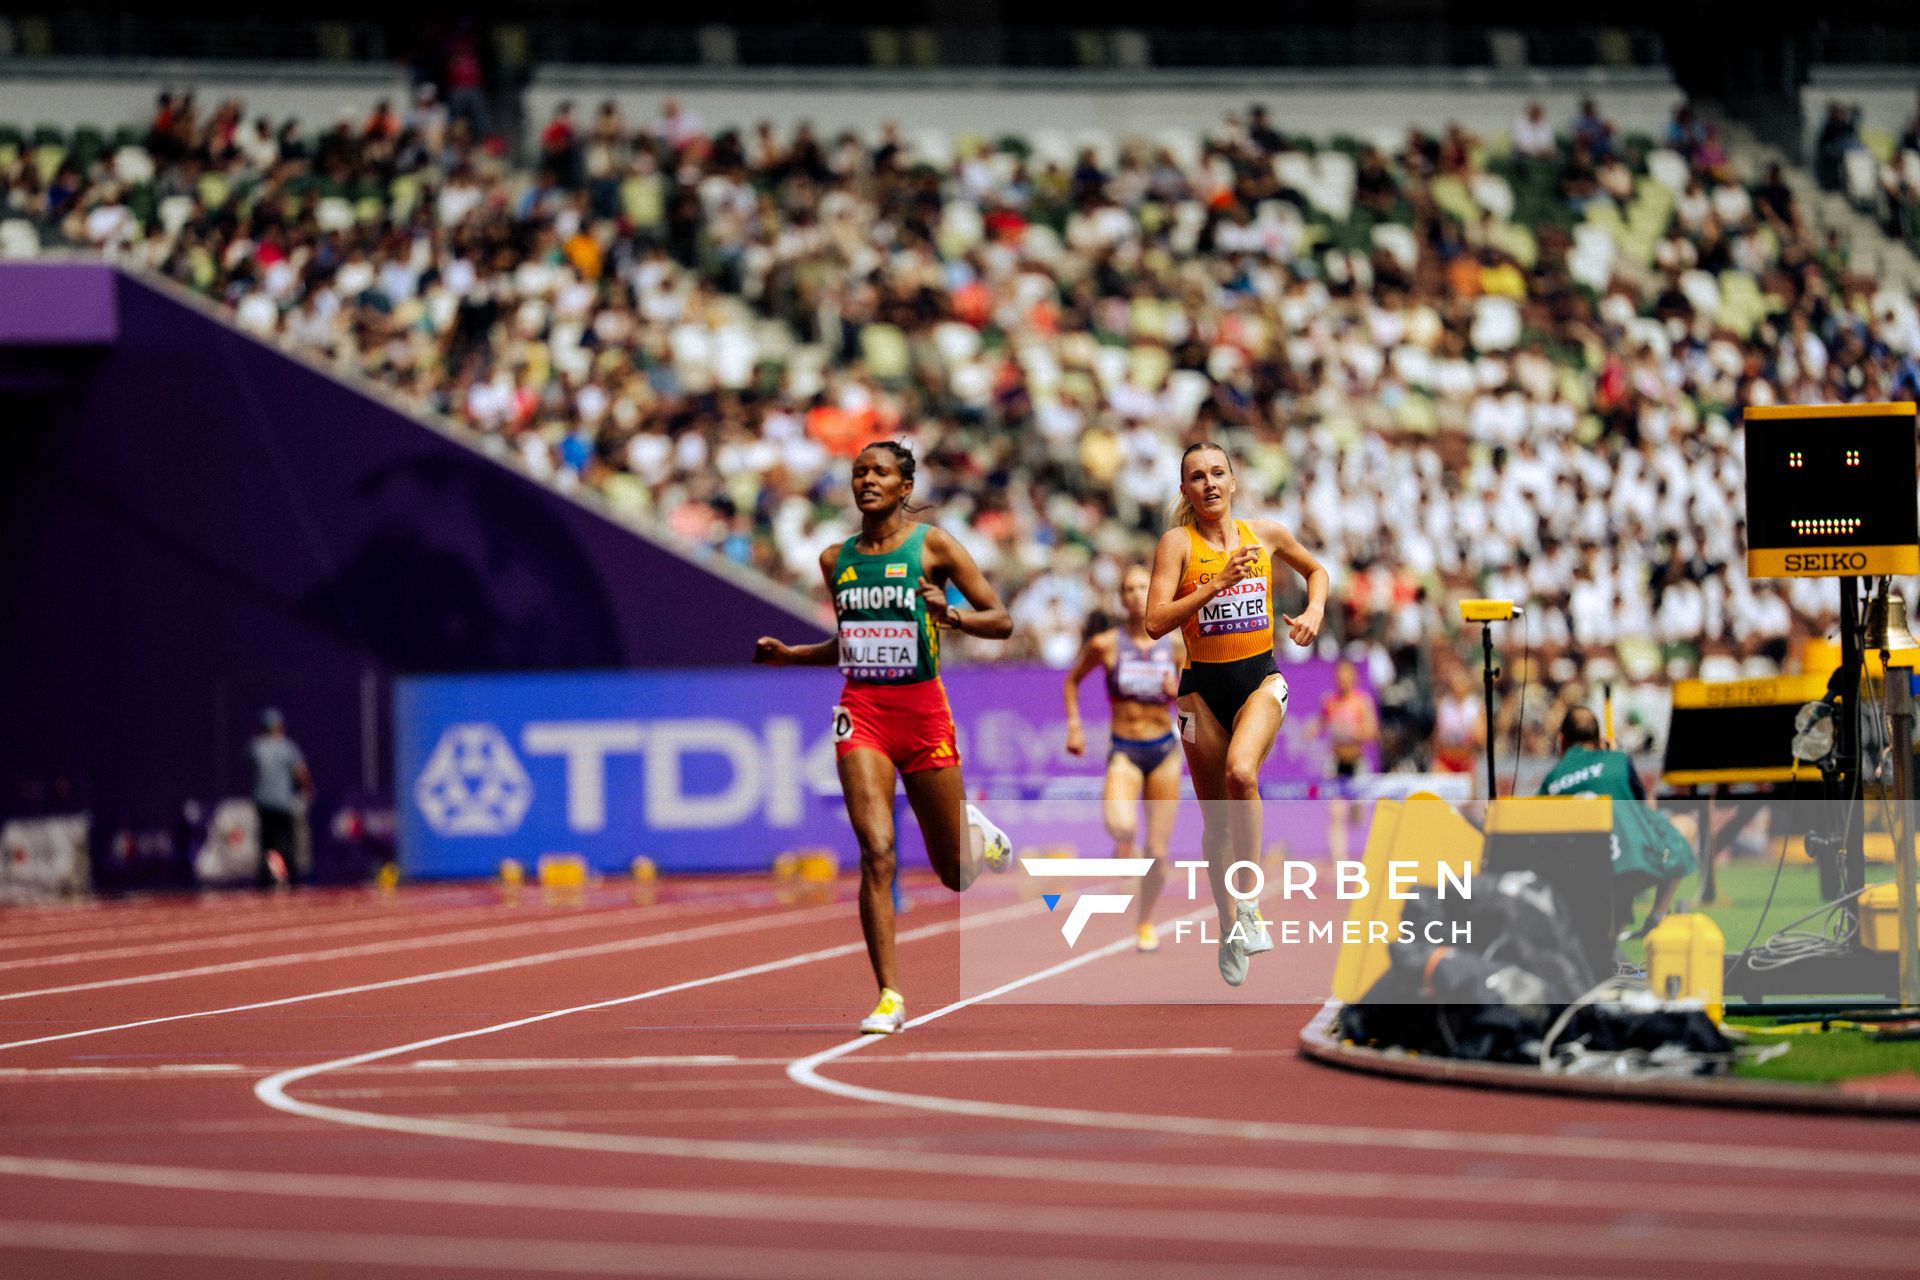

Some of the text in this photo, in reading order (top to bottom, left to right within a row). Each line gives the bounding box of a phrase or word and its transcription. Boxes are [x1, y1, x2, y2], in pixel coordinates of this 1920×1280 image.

[1785, 553, 1867, 572] SEIKO
[1215, 582, 1266, 598] ONDA
[1203, 599, 1264, 620] MEYER
[840, 628, 914, 638] HONDA
[842, 647, 912, 663] MULETA
[1548, 762, 1604, 795] SONY
